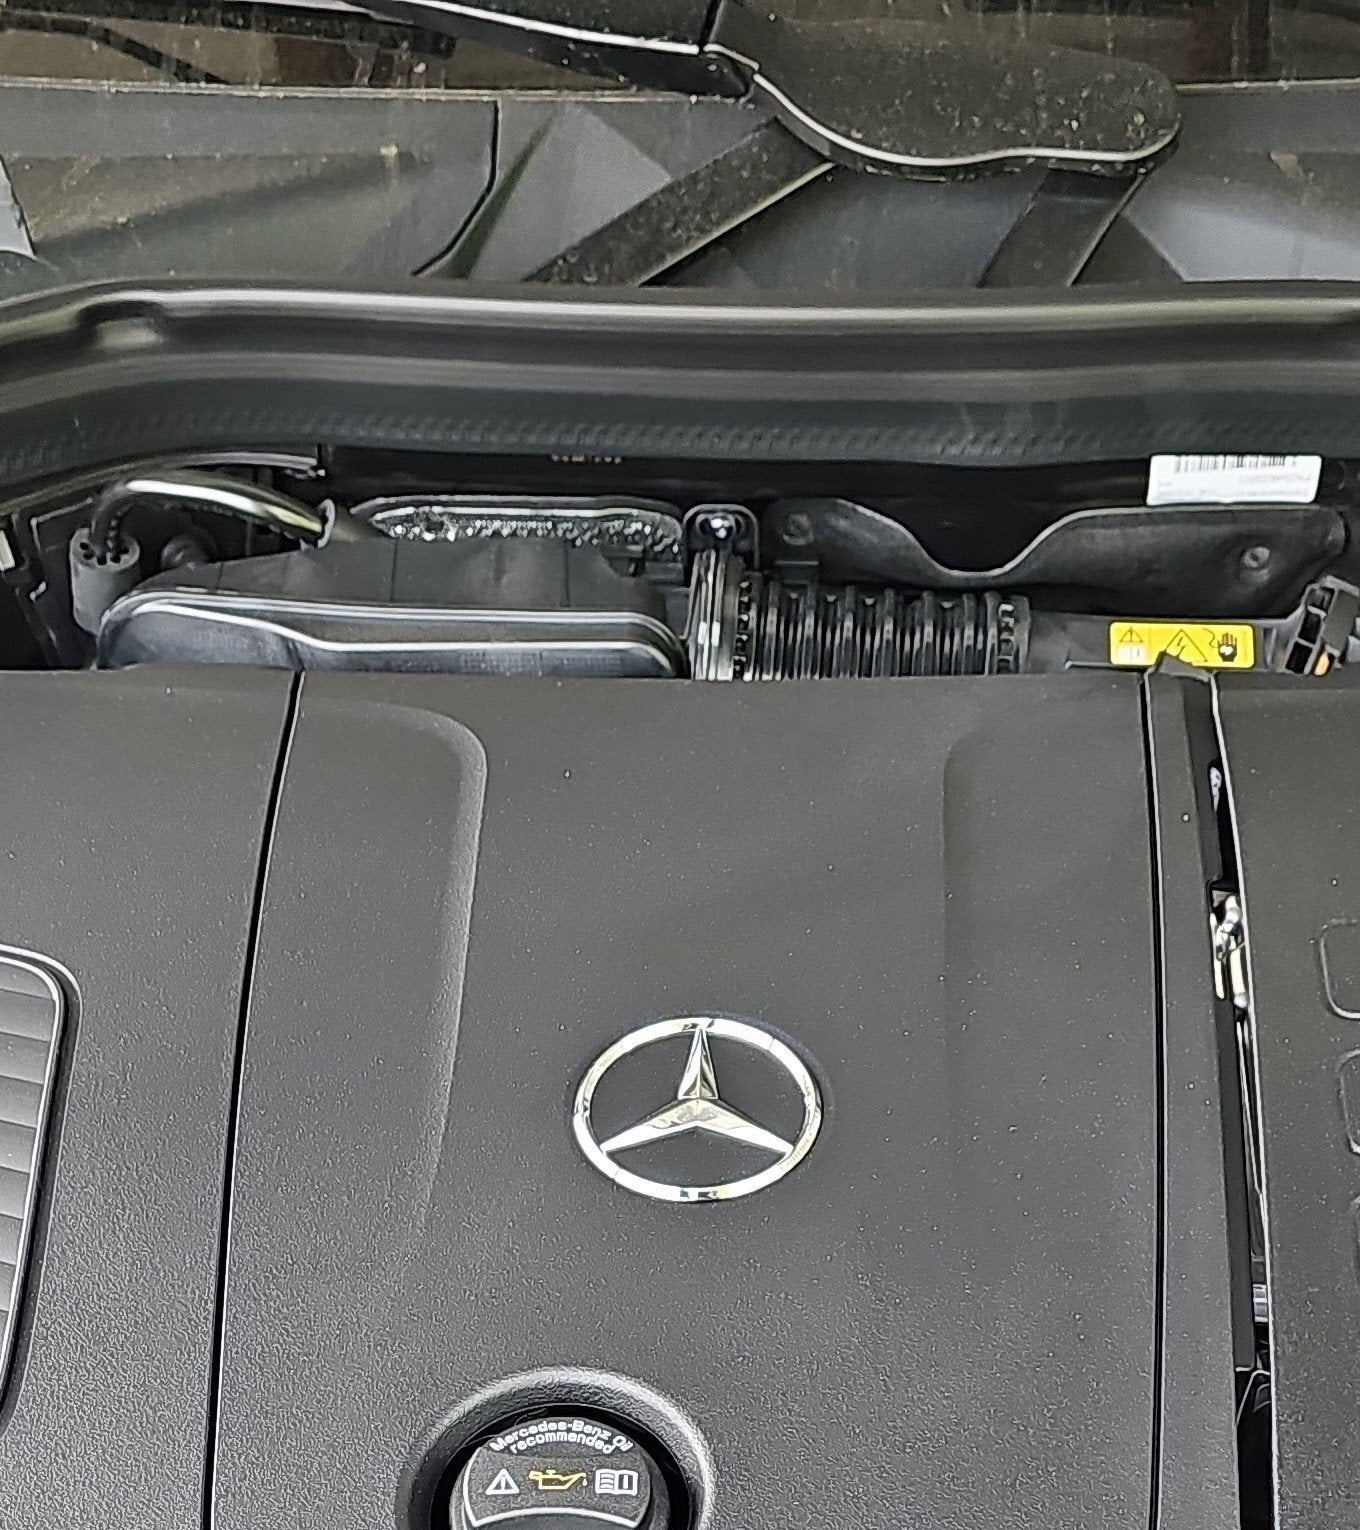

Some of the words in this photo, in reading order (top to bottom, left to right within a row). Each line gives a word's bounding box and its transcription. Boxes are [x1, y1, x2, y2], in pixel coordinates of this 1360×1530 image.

[489, 1419, 610, 1452] Mercedes-Benz
[612, 1435, 635, 1452] Oil
[509, 1431, 616, 1454] recommended
